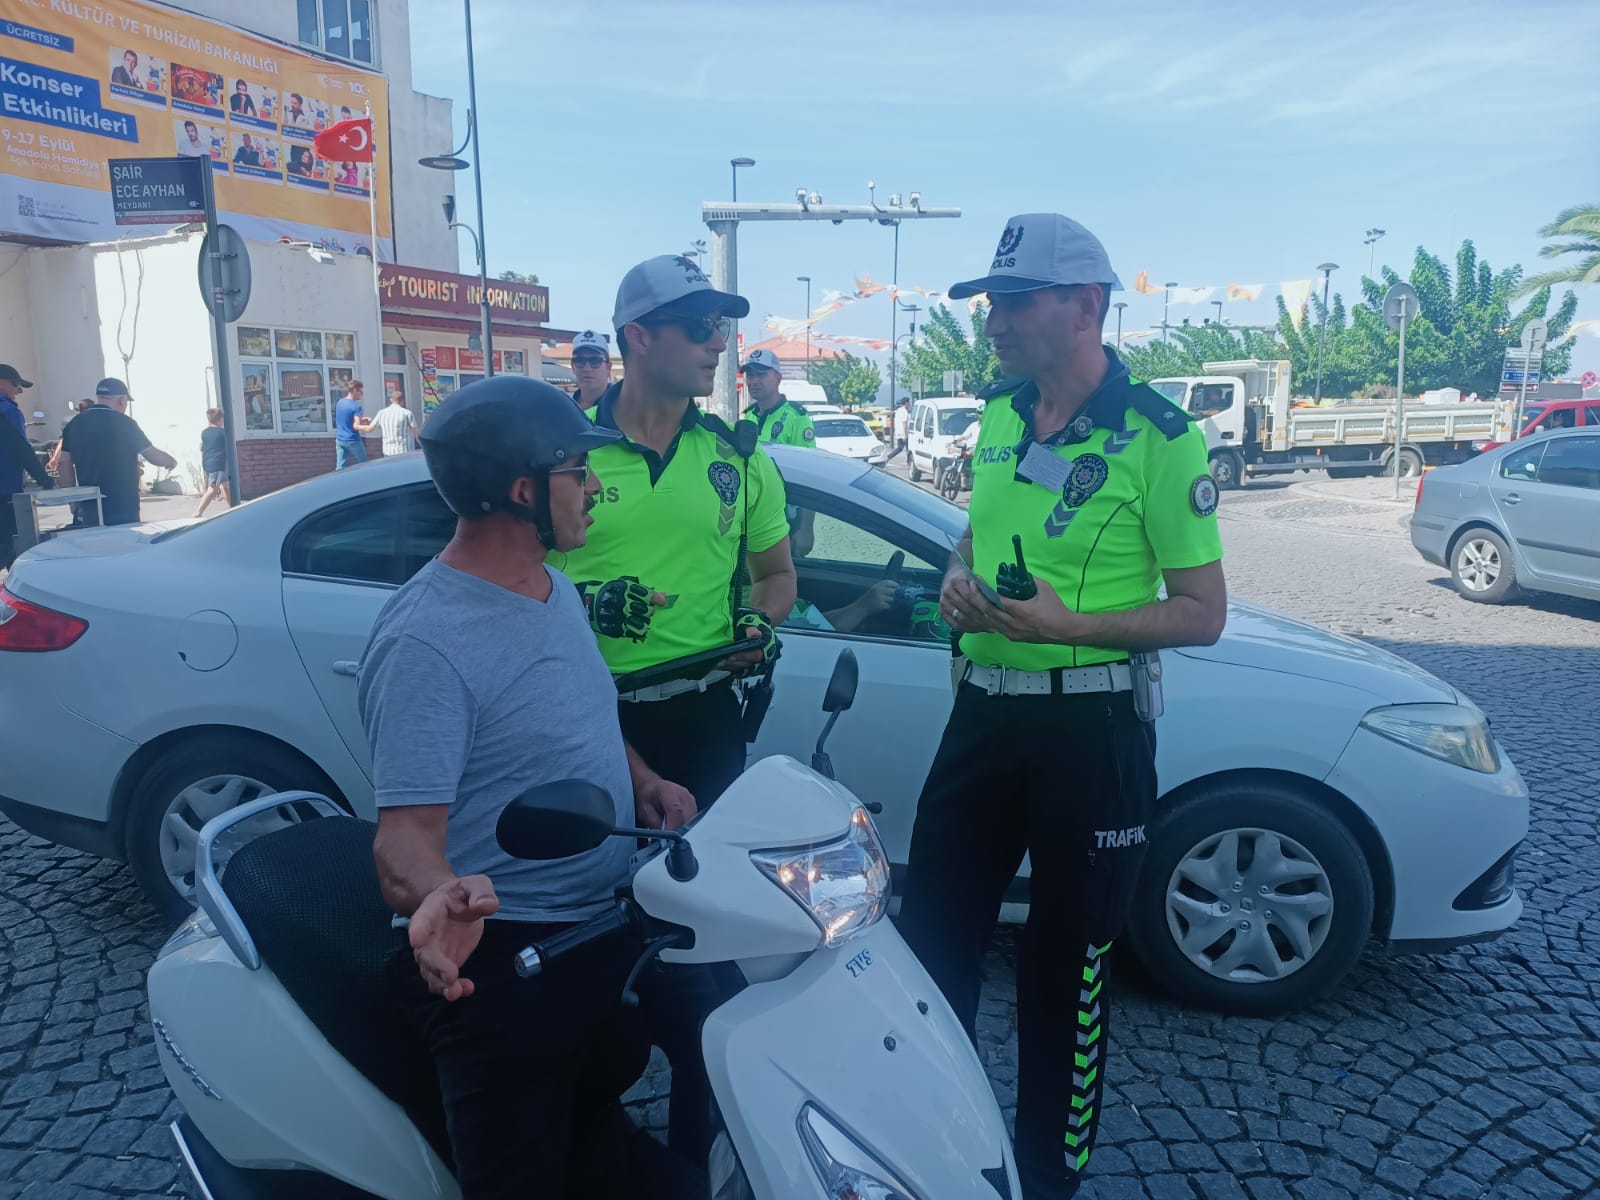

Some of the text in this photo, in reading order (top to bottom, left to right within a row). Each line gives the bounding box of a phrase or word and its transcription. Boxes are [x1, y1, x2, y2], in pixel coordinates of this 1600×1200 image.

[6, 23, 61, 47] ÜCRETSİZ
[119, 17, 140, 34] VE
[143, 23, 201, 51] TURİZM
[204, 40, 279, 74] BAKANLIĞI
[0, 62, 83, 98] Konser
[3, 93, 128, 136] Etkinlikleri
[2, 128, 75, 153] 9-17 Eylül
[7, 145, 50, 160] Anadolu
[113, 160, 143, 182] ŞAİR
[116, 183, 185, 198] ECE AYHAN
[117, 201, 151, 210] MEYDANI
[398, 274, 459, 303] TOURIST
